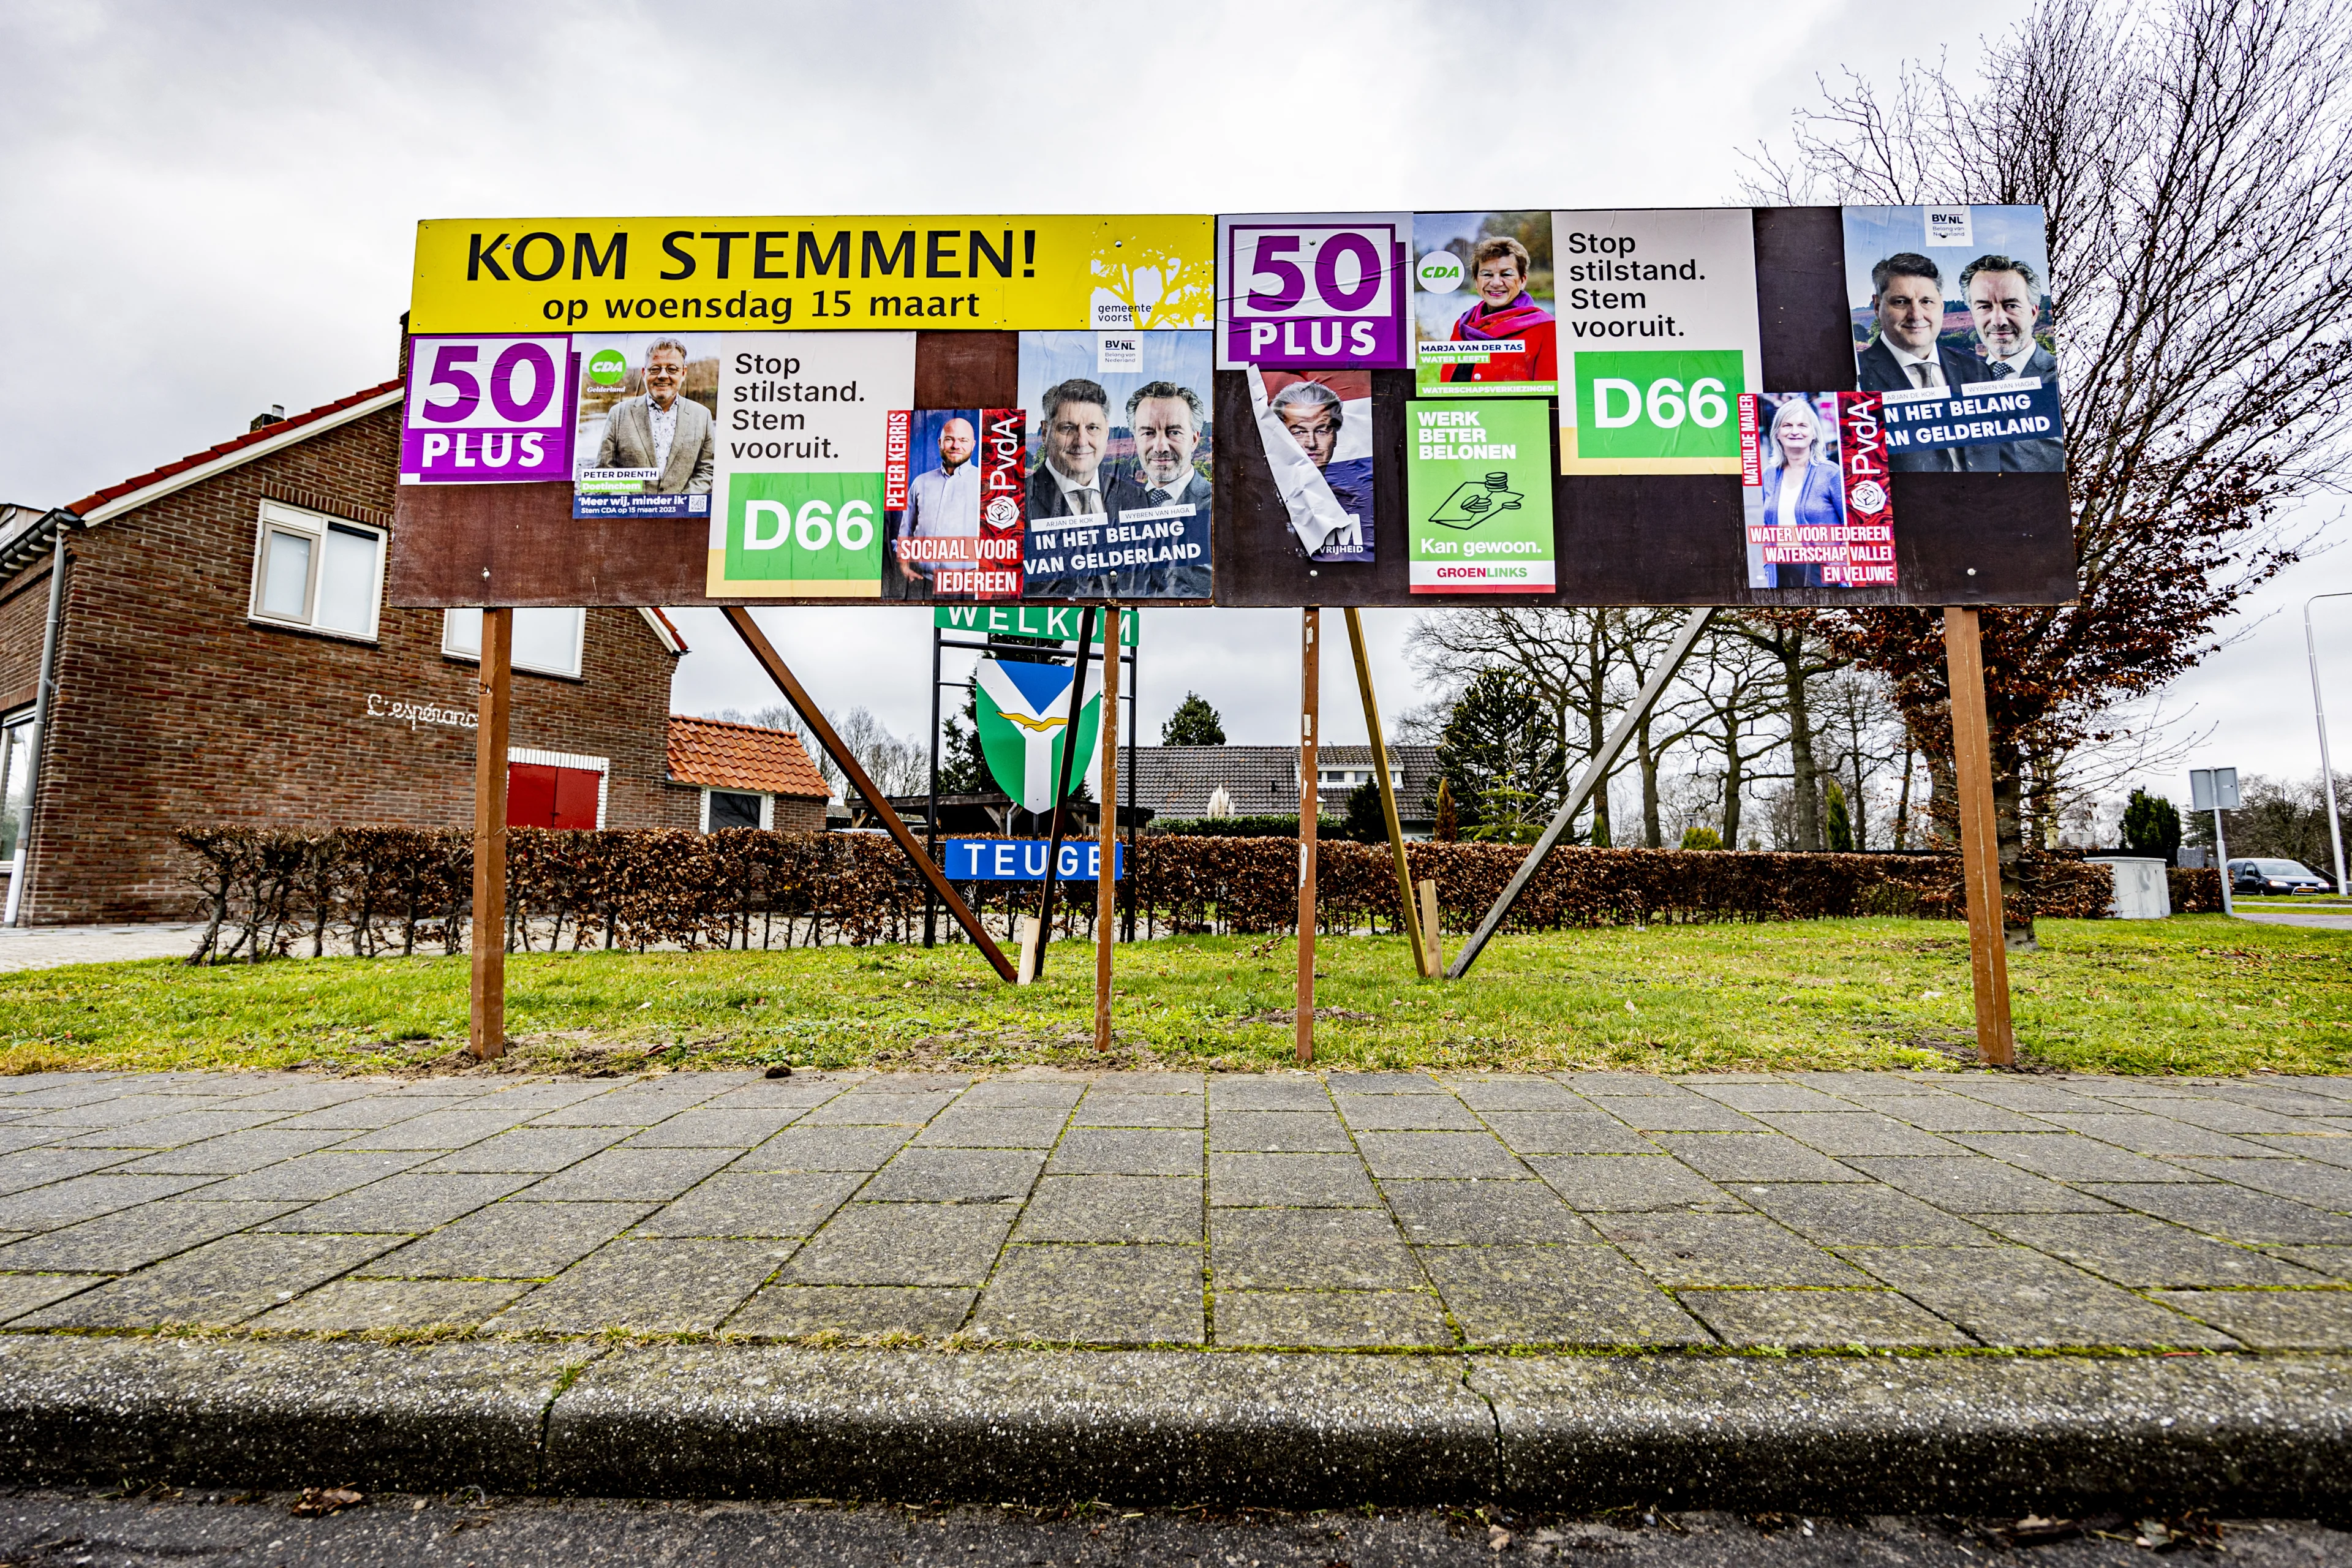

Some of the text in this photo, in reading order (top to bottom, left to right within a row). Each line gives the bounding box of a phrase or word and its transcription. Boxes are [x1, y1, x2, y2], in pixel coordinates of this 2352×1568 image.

[467, 230, 1036, 281] KOM STEMMEN!
[1569, 232, 1636, 258] Stop
[1246, 232, 1382, 312] 50
[1421, 266, 1460, 279] CDA
[1570, 258, 1706, 282] stilstand.
[543, 290, 980, 325] op woensdag 15 maart
[1098, 304, 1152, 314] gemeente
[1570, 287, 1647, 310] Stem
[1098, 313, 1133, 322] voorst
[1571, 314, 1685, 339] vooruit.
[1250, 320, 1377, 356] PLUS
[592, 361, 623, 373] CDA
[735, 353, 800, 379] Stop
[422, 342, 556, 423] 50
[733, 380, 864, 402] stilstand.
[1422, 385, 1555, 394] WATERSCHAPSVERKIEZINGEN
[2015, 380, 2035, 389] HAGA
[1594, 377, 1728, 429] D66
[1883, 394, 2032, 423] N HET BELANG
[732, 409, 805, 430] Stem
[1418, 410, 1480, 427] WERK
[1418, 428, 1487, 443] BETER
[1739, 395, 1759, 484] MATHILDE MAIJER
[1847, 399, 1881, 475] PvdA
[1885, 415, 2051, 447] AN GELDERLAND
[421, 432, 545, 468] PLUS
[730, 436, 839, 459] vooruit.
[989, 417, 1018, 490] PvdA
[1419, 444, 1516, 460] BELONEN
[886, 413, 908, 507] PETER KERRIS
[582, 481, 641, 491] Doetinchem
[610, 497, 630, 507] wij,
[632, 496, 672, 505] minder
[743, 500, 873, 551] D66
[1125, 511, 1153, 519] WYBREN
[1035, 521, 1185, 550] IN HET BELANG
[1750, 526, 1891, 543] WATER VOOR IEDEREEN
[900, 539, 1017, 560] SOCIAAL VOOR
[1023, 543, 1202, 575] VAN GELDERLAND
[1320, 545, 1363, 555] VRIJHEID
[1420, 538, 1542, 558] Kan gewoon.
[1765, 546, 1892, 562] WATERSCHAP VALLEI
[937, 571, 1016, 592] IEDEREEN
[1437, 566, 1528, 579] GROENLINKS
[1823, 566, 1894, 582] EN VELUWE
